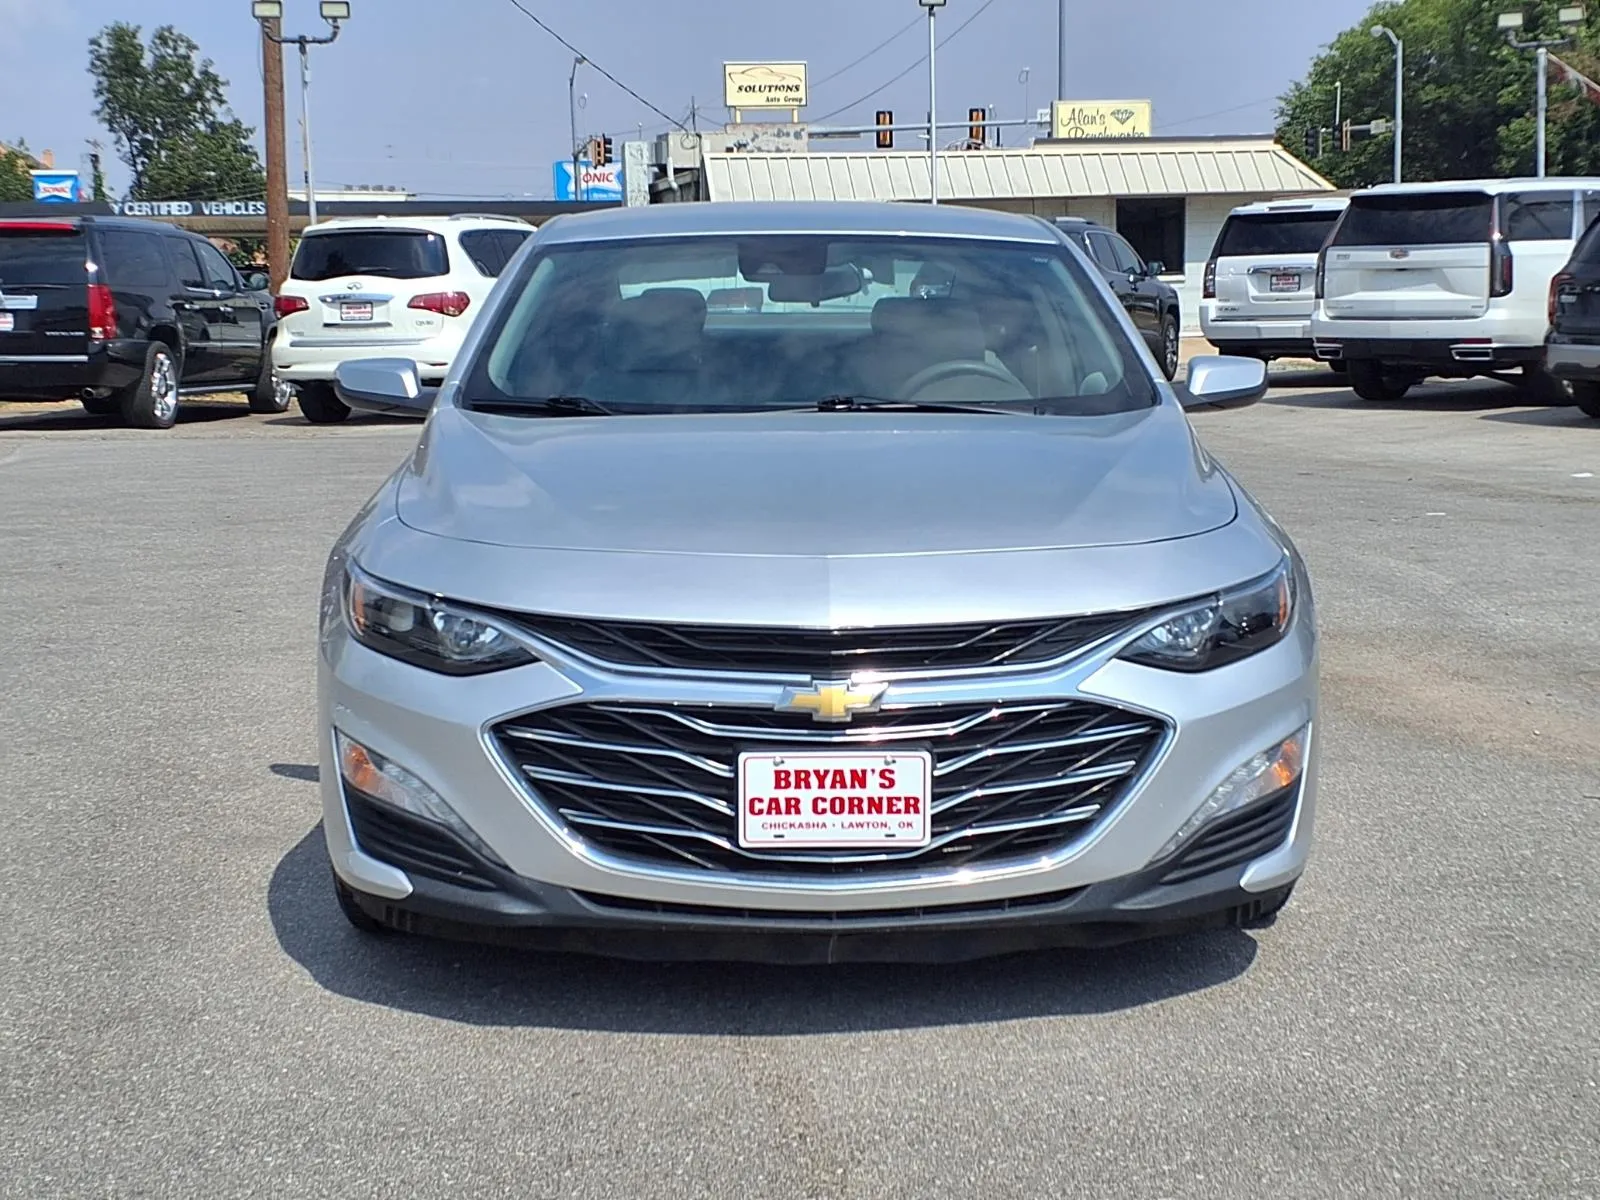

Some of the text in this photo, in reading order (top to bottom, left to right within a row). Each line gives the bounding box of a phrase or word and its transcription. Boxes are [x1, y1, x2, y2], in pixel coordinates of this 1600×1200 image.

[737, 84, 800, 93] SOLUTIONS
[783, 96, 803, 104] Group
[1060, 107, 1106, 126] Alan's
[124, 201, 193, 216] CERTIFIED
[201, 201, 267, 215] VEHICLES
[774, 768, 896, 790] BRYAN'S
[749, 796, 920, 816] CAR CORNER
[761, 821, 914, 831] CHICKASHA LAWTON, OK
